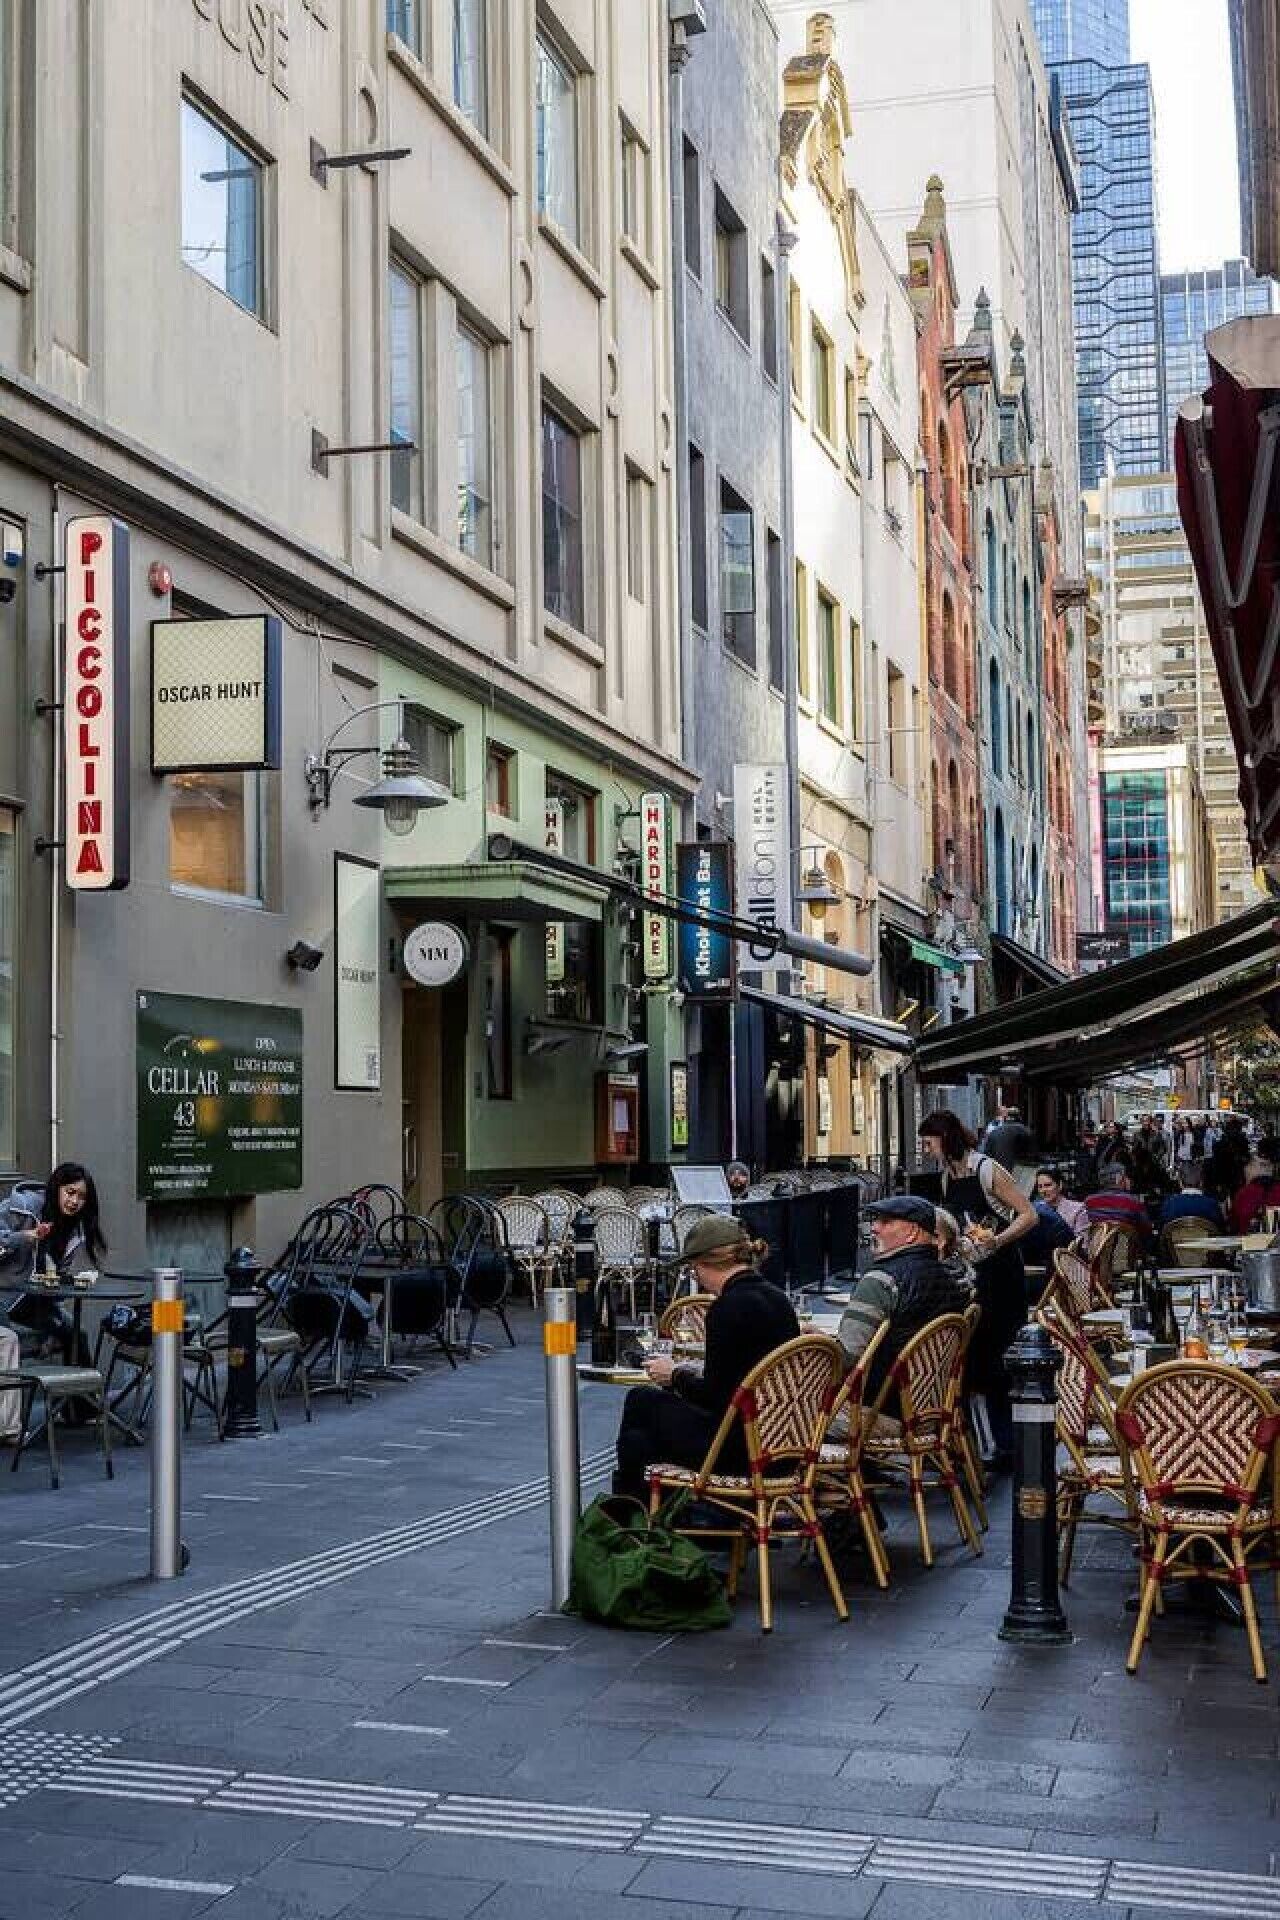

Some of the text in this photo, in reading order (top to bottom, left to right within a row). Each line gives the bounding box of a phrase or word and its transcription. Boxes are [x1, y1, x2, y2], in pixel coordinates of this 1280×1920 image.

[76, 531, 104, 873] PICCOLINA
[158, 681, 262, 703] OSCAR HUNT
[753, 787, 763, 824] REAL
[765, 771, 775, 824] ESTATE
[696, 850, 711, 883] Bar
[148, 1066, 220, 1095] CELLAR
[173, 1101, 196, 1127] 43
